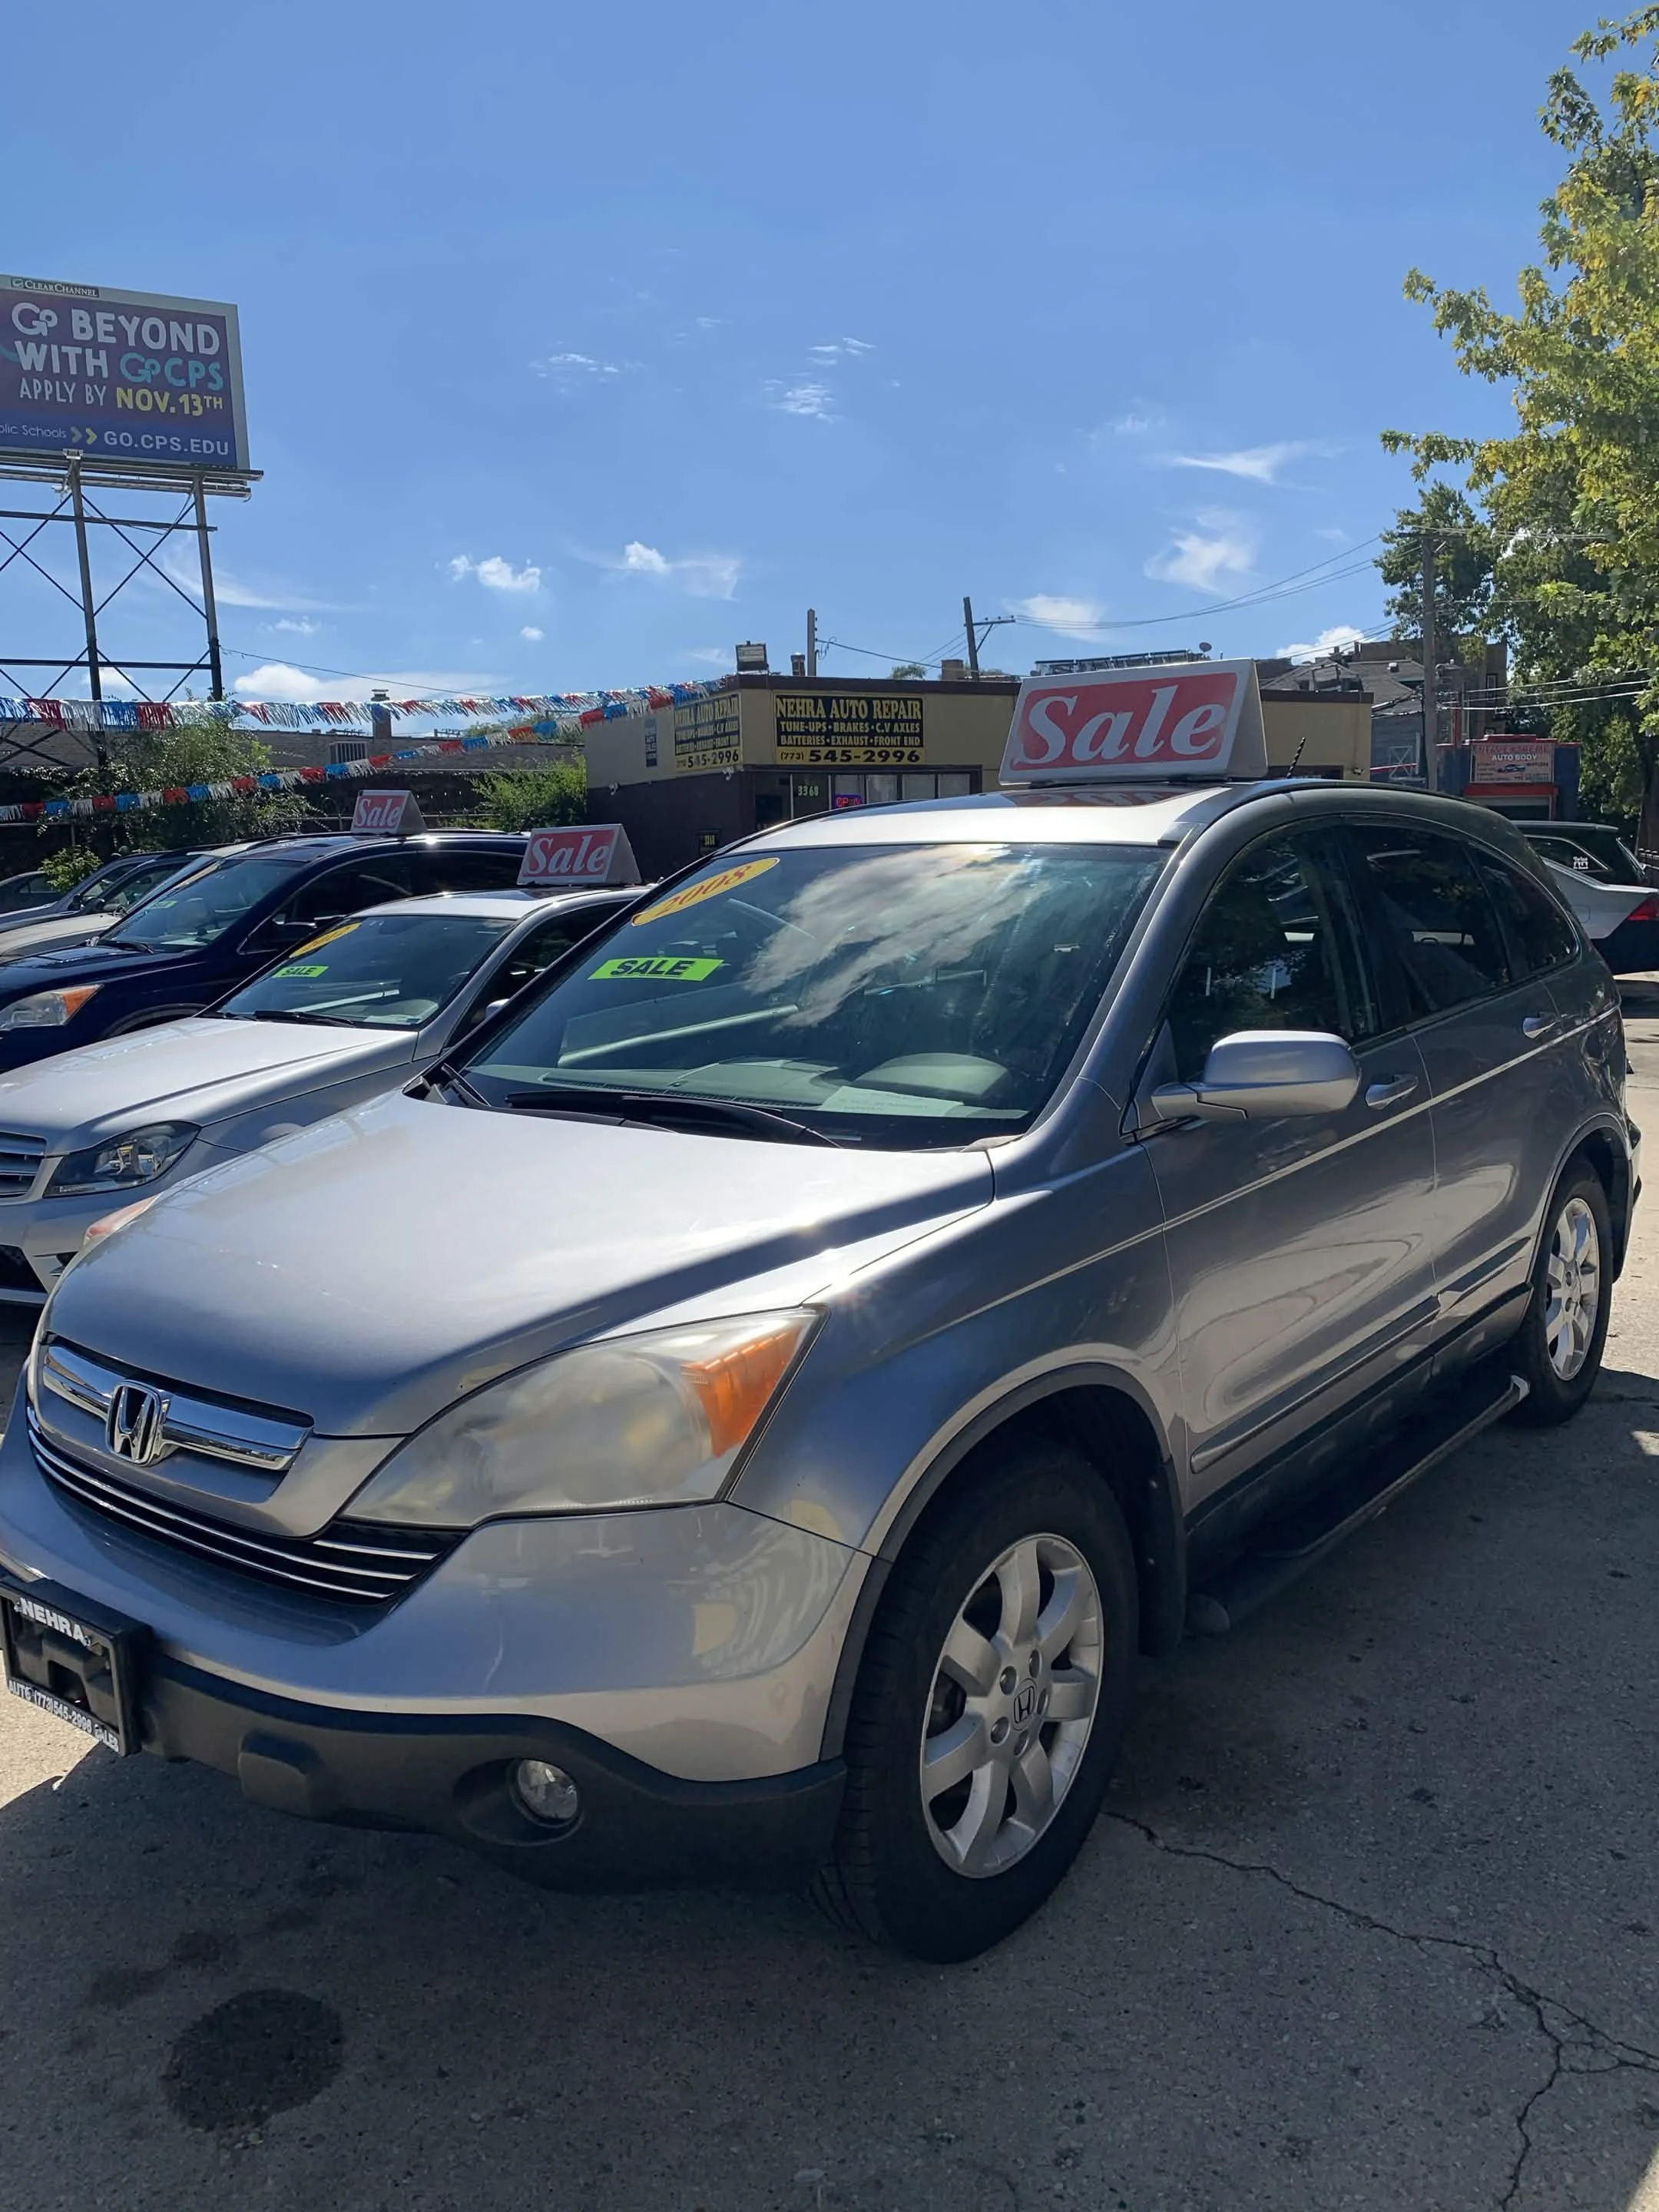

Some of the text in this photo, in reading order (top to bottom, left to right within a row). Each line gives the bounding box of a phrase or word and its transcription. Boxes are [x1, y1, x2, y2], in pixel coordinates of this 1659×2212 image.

[71, 308, 220, 355] BEYOND
[14, 340, 108, 379] WITH
[19, 377, 76, 403] APPLY
[85, 384, 107, 406] BY
[117, 387, 175, 413] NOV.
[22, 424, 67, 439] Schools
[104, 430, 228, 455] GO.CPS.EDU
[776, 697, 922, 720] NEHRA AUTO REPAIR
[780, 721, 826, 732] TUNE-UPS
[833, 722, 869, 732] BRAKES
[893, 723, 920, 733] AXLES
[1013, 684, 1227, 764] Sale
[780, 735, 920, 746] BATTERIES EXHAUST FRONT END
[780, 750, 920, 763] (773) 545-2996
[355, 797, 399, 828] Sale
[525, 835, 608, 874] Sale
[652, 866, 752, 916] 2008
[281, 967, 317, 976] SALE
[610, 959, 696, 976] SALE
[20, 1597, 87, 1647] NEHRA
